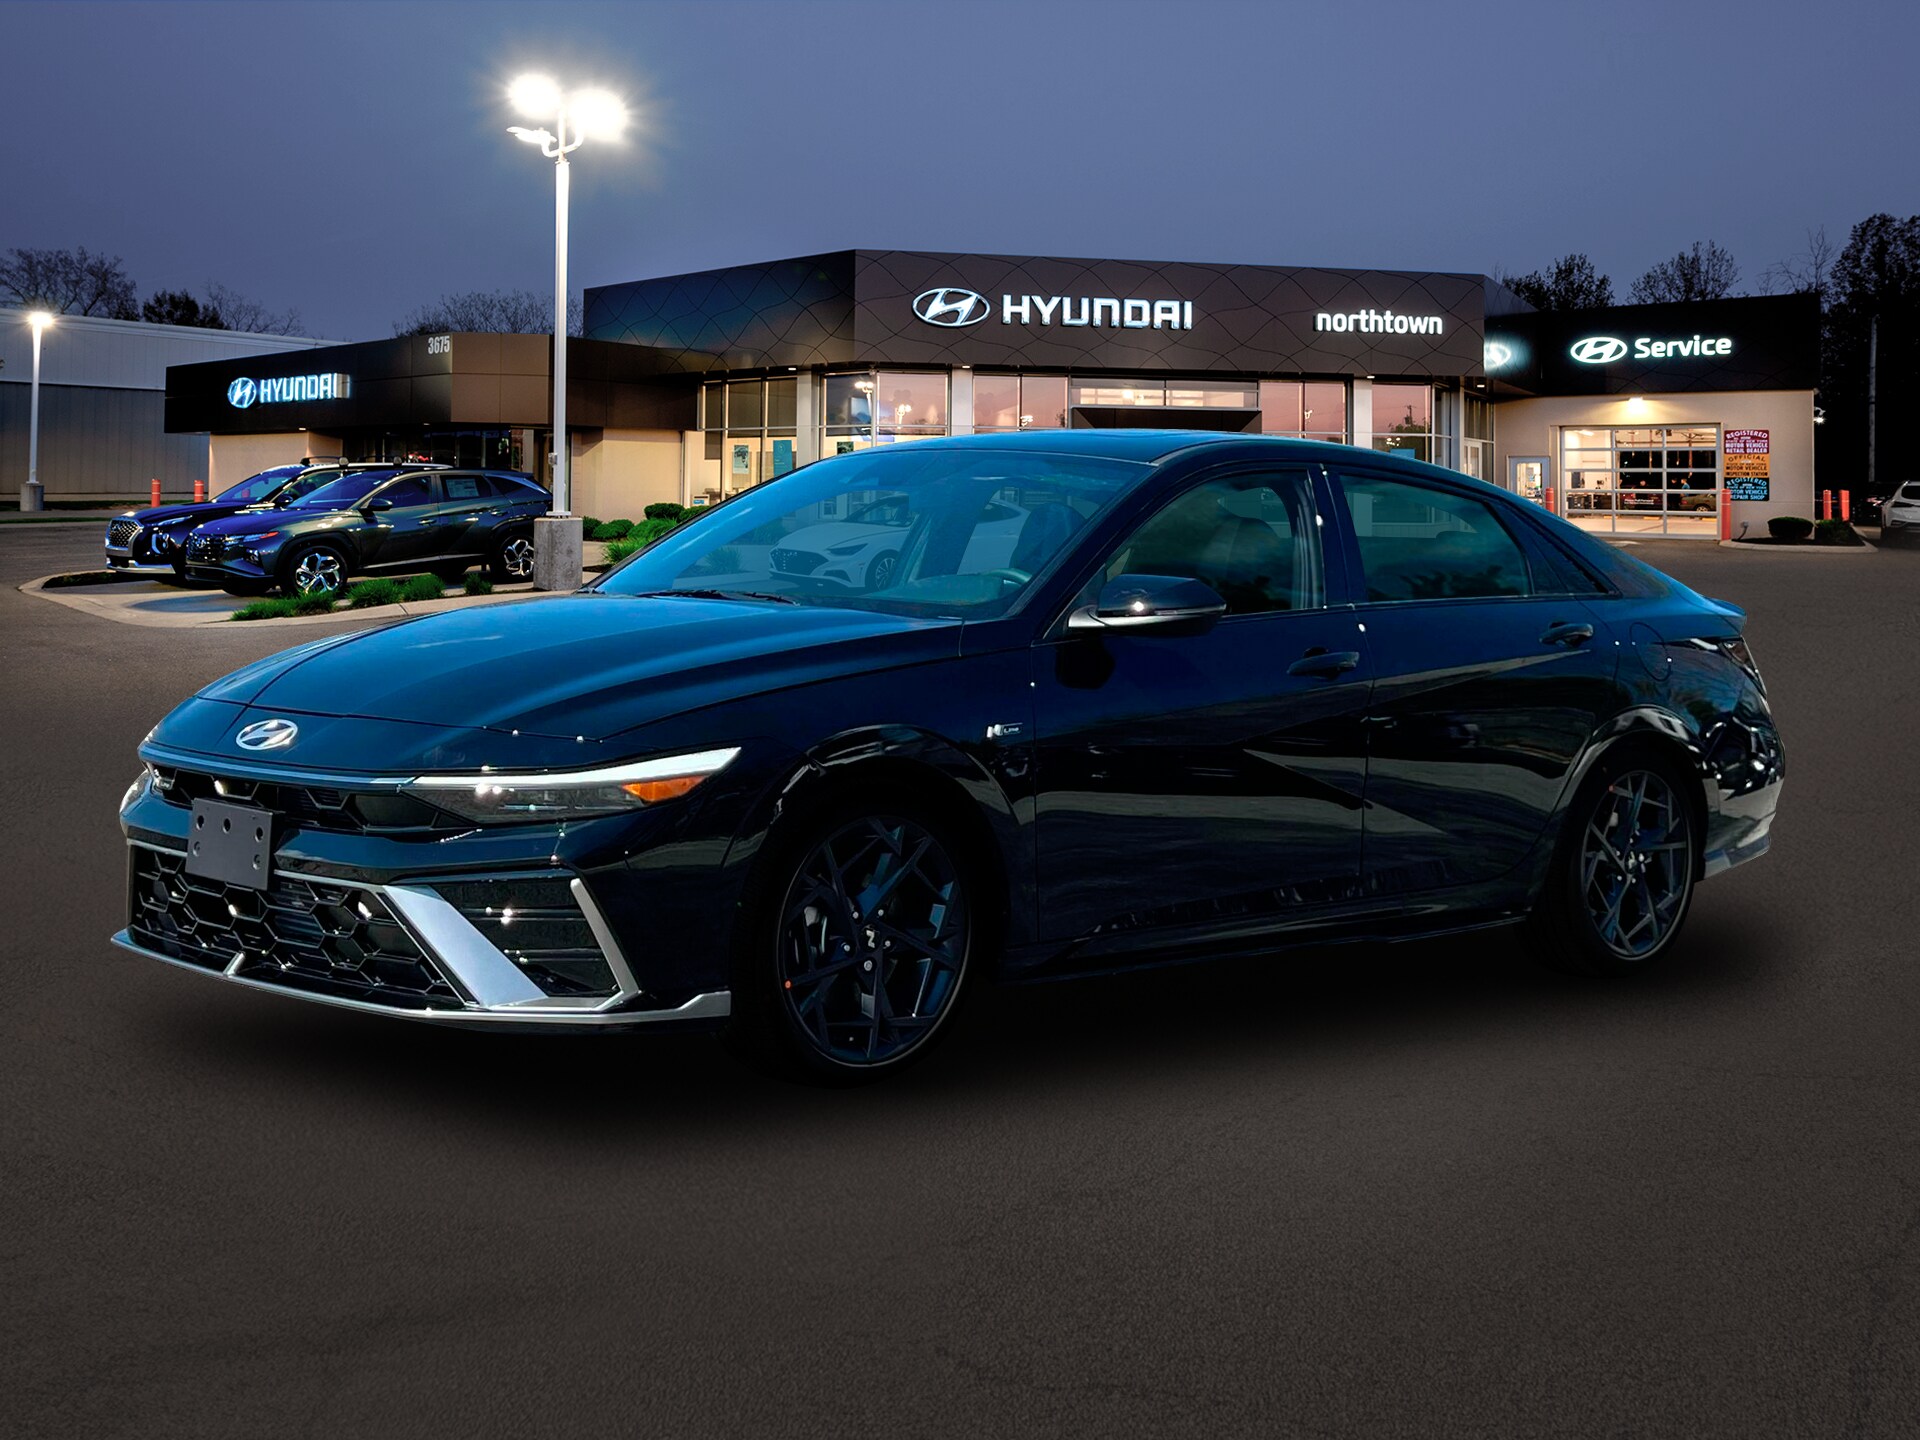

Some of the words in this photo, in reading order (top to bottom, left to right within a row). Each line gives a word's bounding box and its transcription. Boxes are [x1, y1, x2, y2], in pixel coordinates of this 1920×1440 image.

[1002, 294, 1193, 330] HYUNDAI
[1316, 309, 1443, 335] northtown
[428, 335, 450, 354] 3675
[1633, 335, 1733, 359] Service
[259, 372, 341, 404] HYUNDAI
[1726, 430, 1768, 438] REGISTERED
[1728, 454, 1765, 462] OFFICIAL
[1726, 477, 1767, 486] REGISTERED
